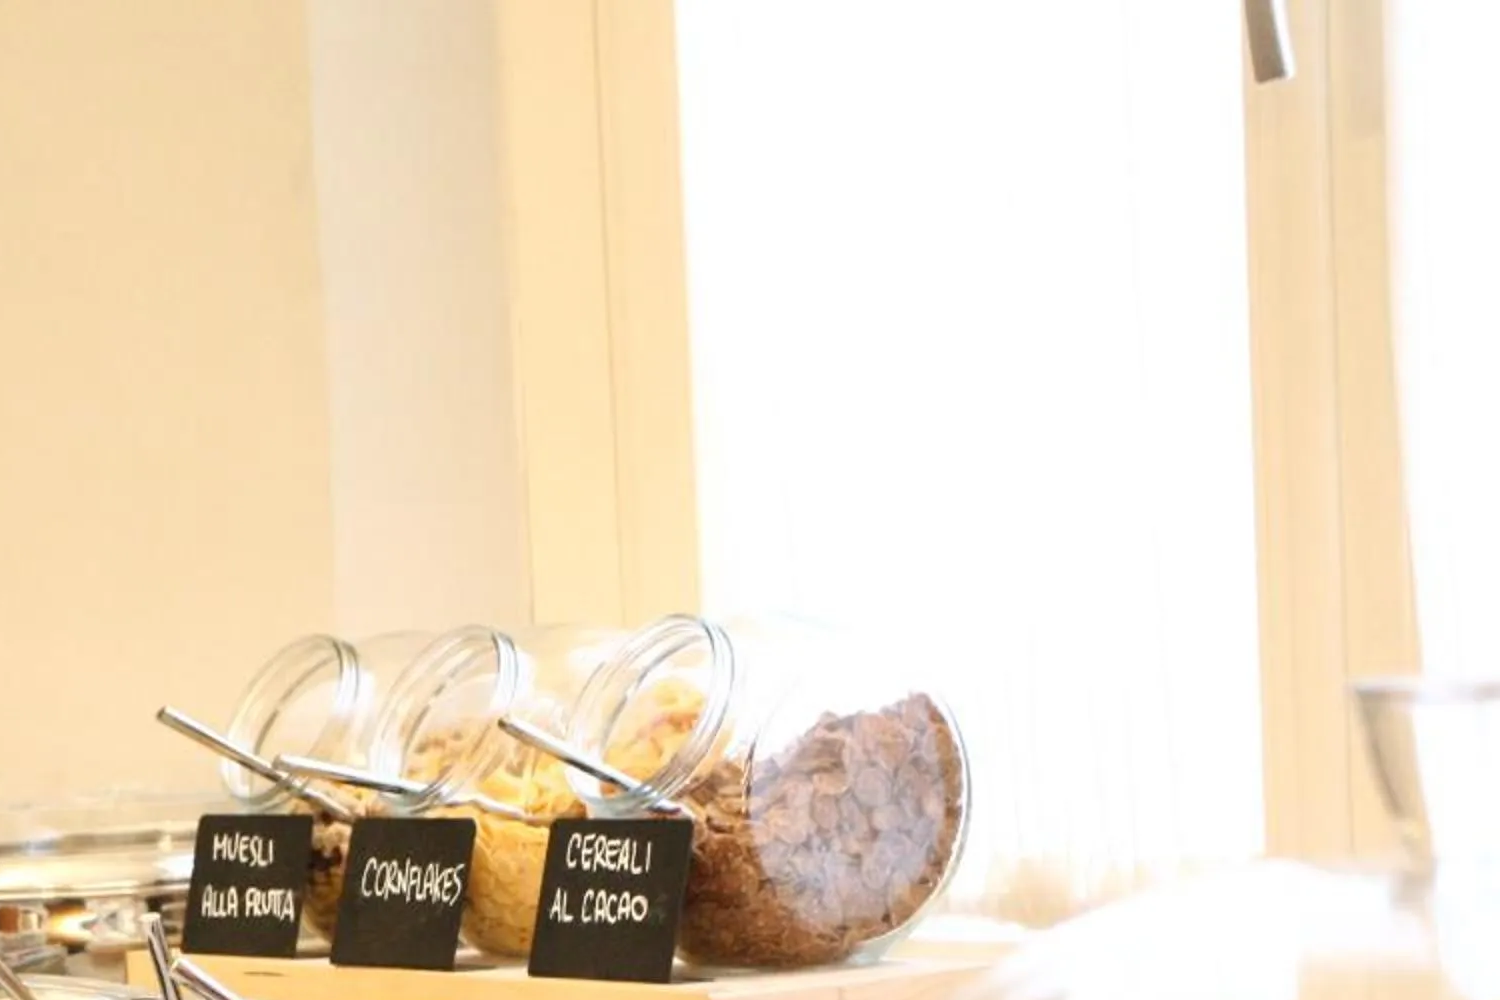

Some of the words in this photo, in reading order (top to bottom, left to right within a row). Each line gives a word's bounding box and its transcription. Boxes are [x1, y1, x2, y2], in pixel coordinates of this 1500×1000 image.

[212, 831, 275, 868] MUESLI
[565, 832, 652, 875] CEREALI
[361, 856, 466, 907] CORNFLAKES
[201, 883, 239, 918] ALLA
[244, 886, 296, 923] FRUTTA
[549, 887, 574, 923] AL
[581, 888, 649, 924] CACAO
